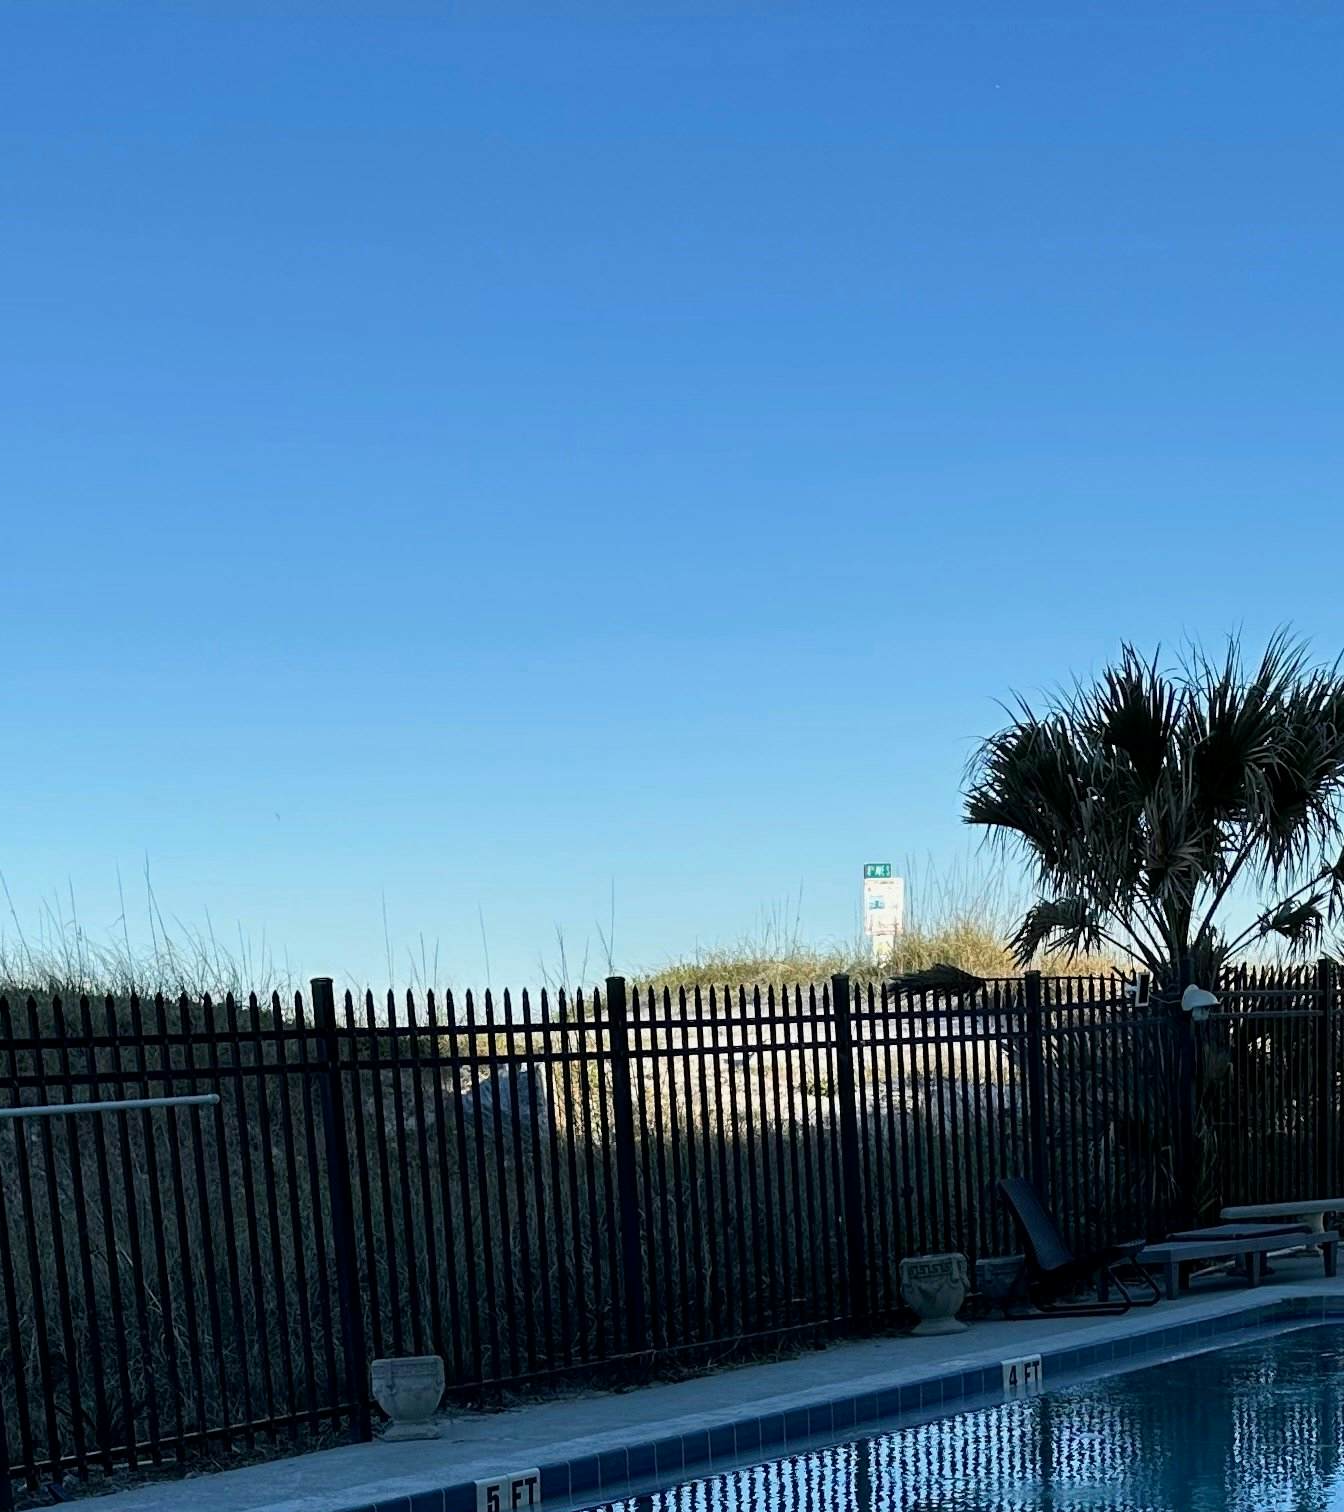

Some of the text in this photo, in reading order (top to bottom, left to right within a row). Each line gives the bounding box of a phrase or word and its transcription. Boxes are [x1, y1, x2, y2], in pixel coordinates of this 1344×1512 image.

[1008, 1360, 1040, 1387] 4 FT
[511, 1476, 538, 1511] FT
